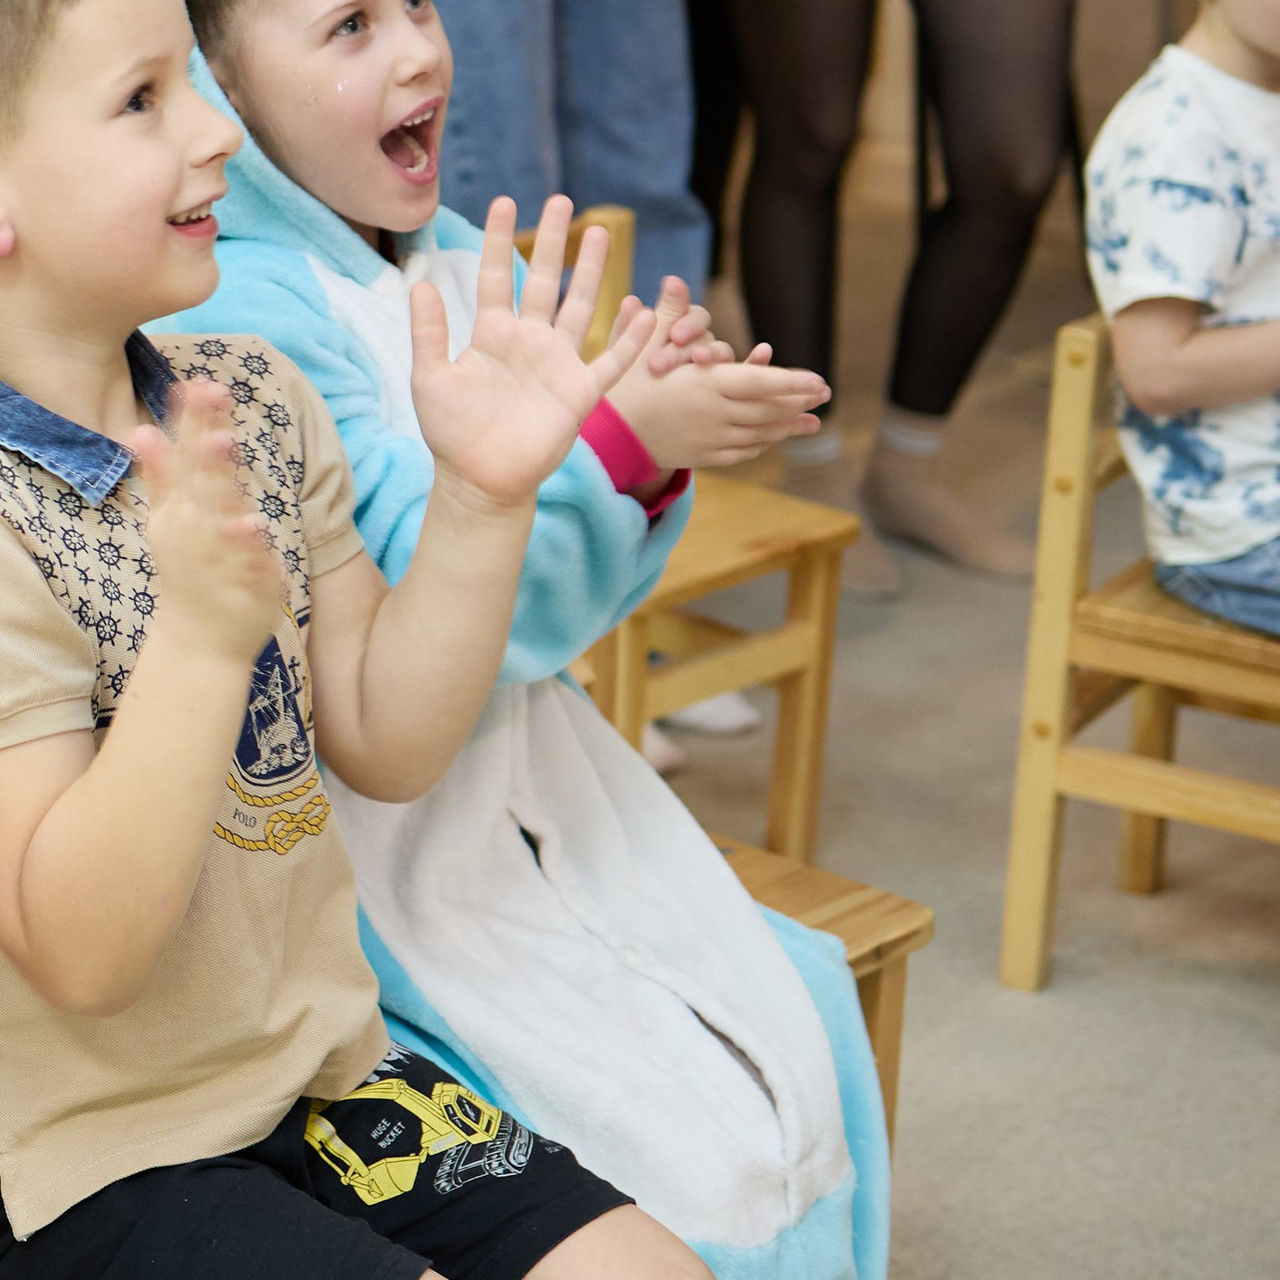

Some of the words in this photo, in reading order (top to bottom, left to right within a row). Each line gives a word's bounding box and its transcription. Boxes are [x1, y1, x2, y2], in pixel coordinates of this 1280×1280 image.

[233, 808, 257, 828] POLO
[370, 1118, 391, 1140] HUGE
[378, 1121, 406, 1149] BUCKET
